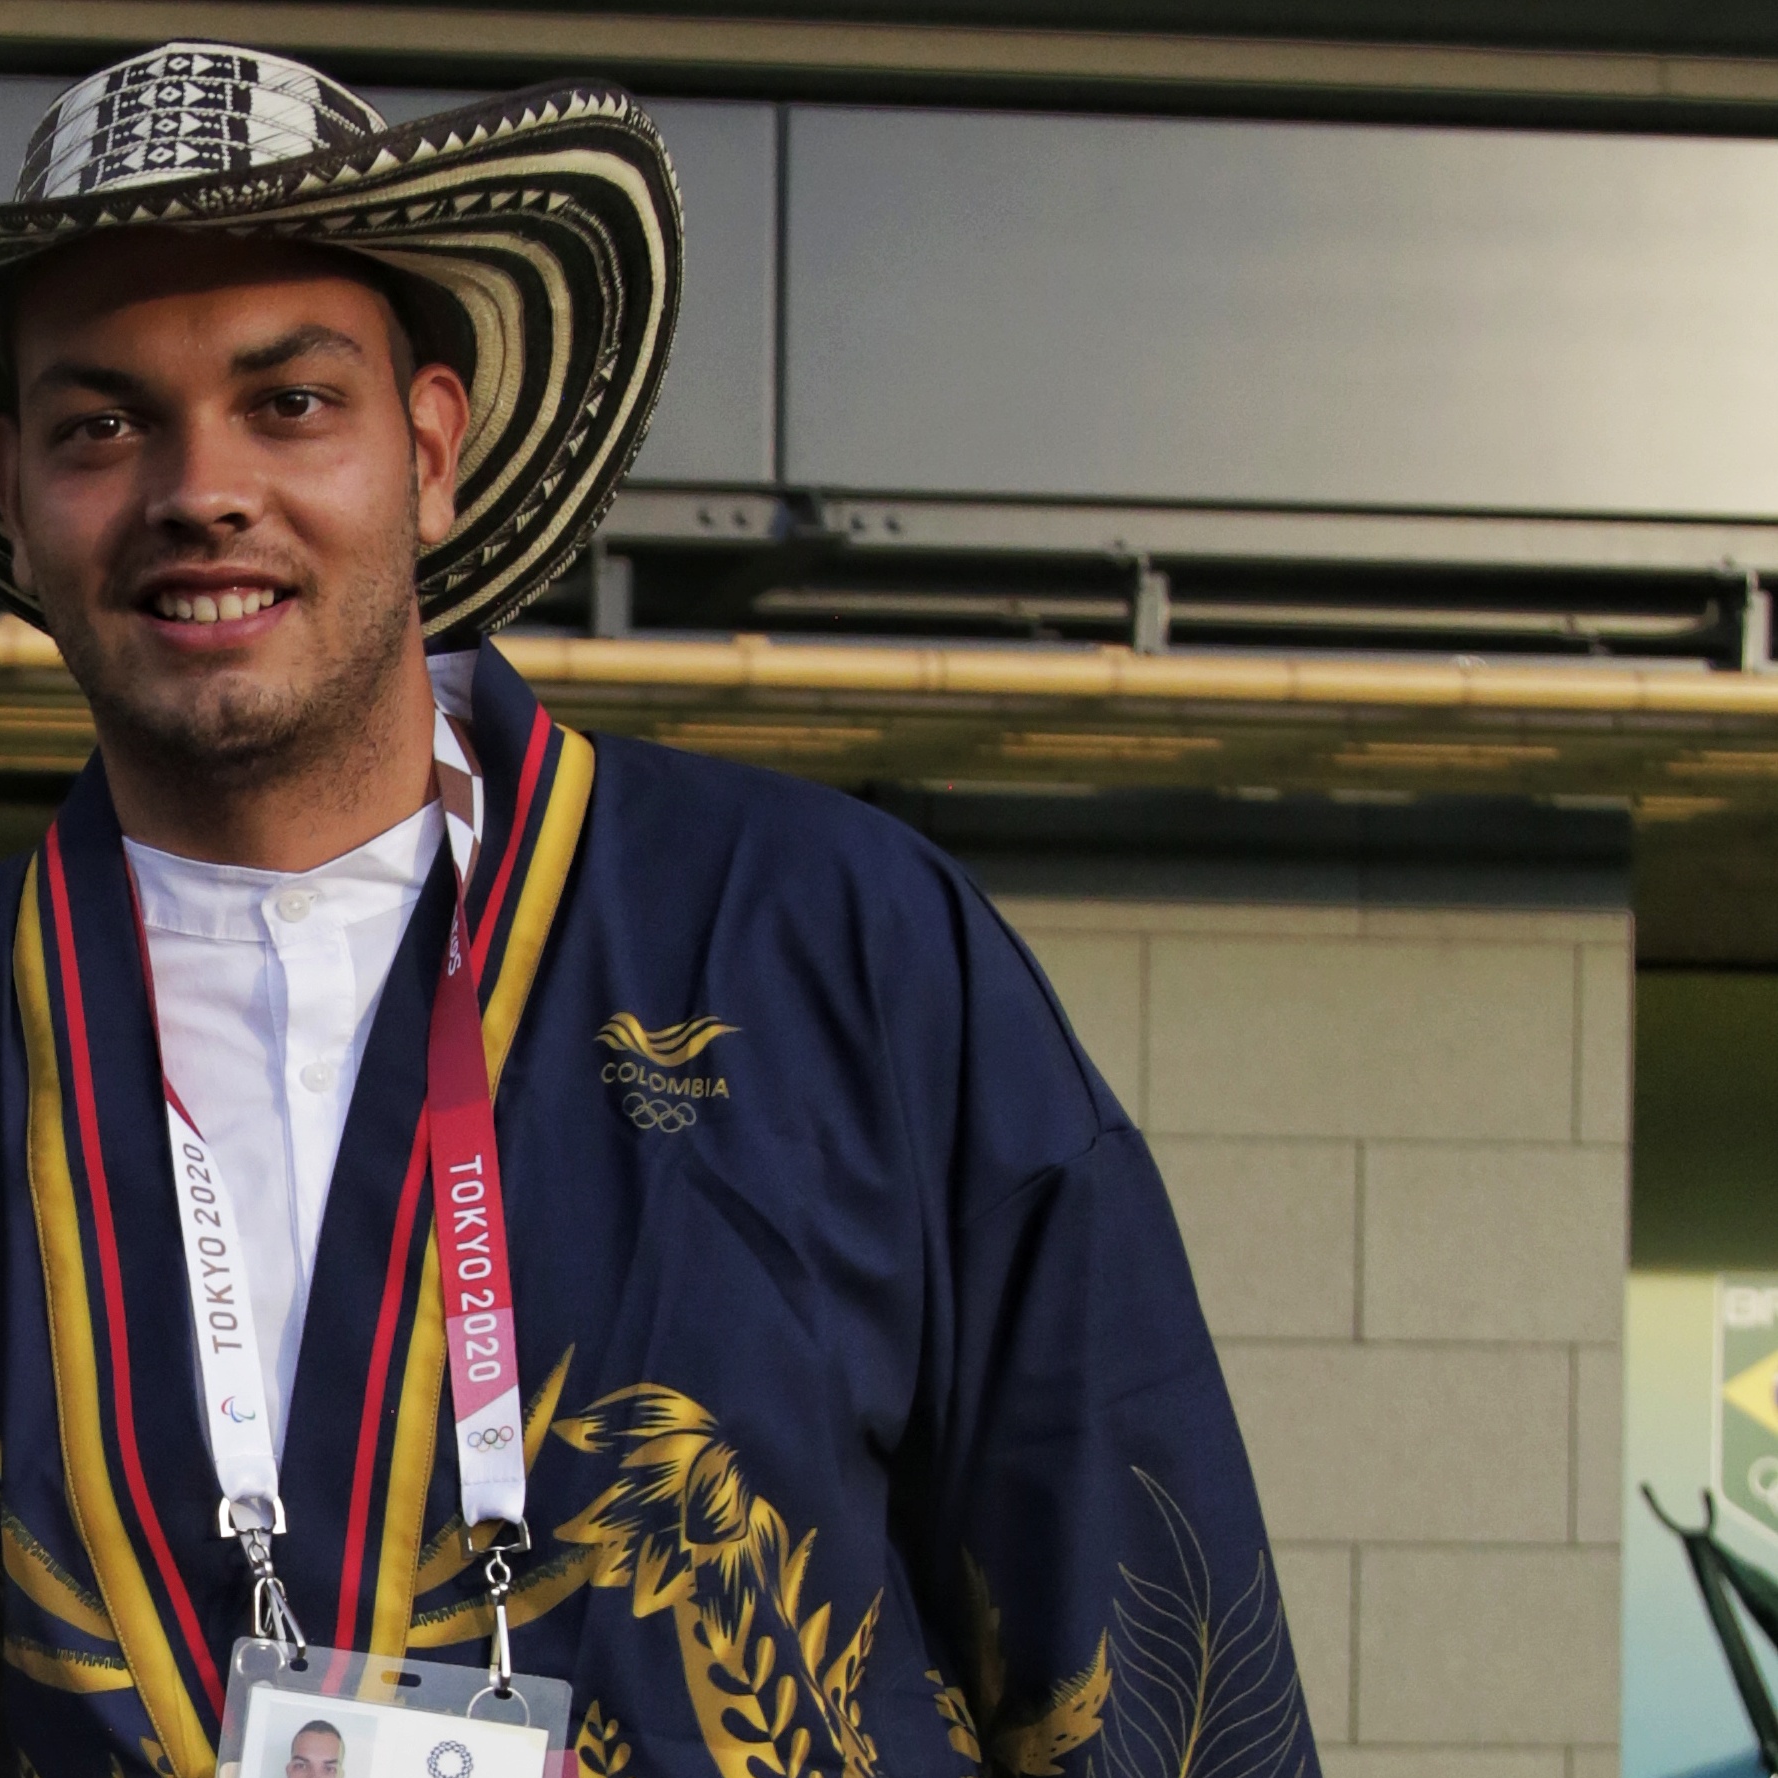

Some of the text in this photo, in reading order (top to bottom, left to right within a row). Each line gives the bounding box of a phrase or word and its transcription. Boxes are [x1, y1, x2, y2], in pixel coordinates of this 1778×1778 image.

[600, 1061, 730, 1099] COLOMBIA
[183, 1142, 243, 1354] TOKYO 2020
[449, 1154, 502, 1383] TOKYO 2020
